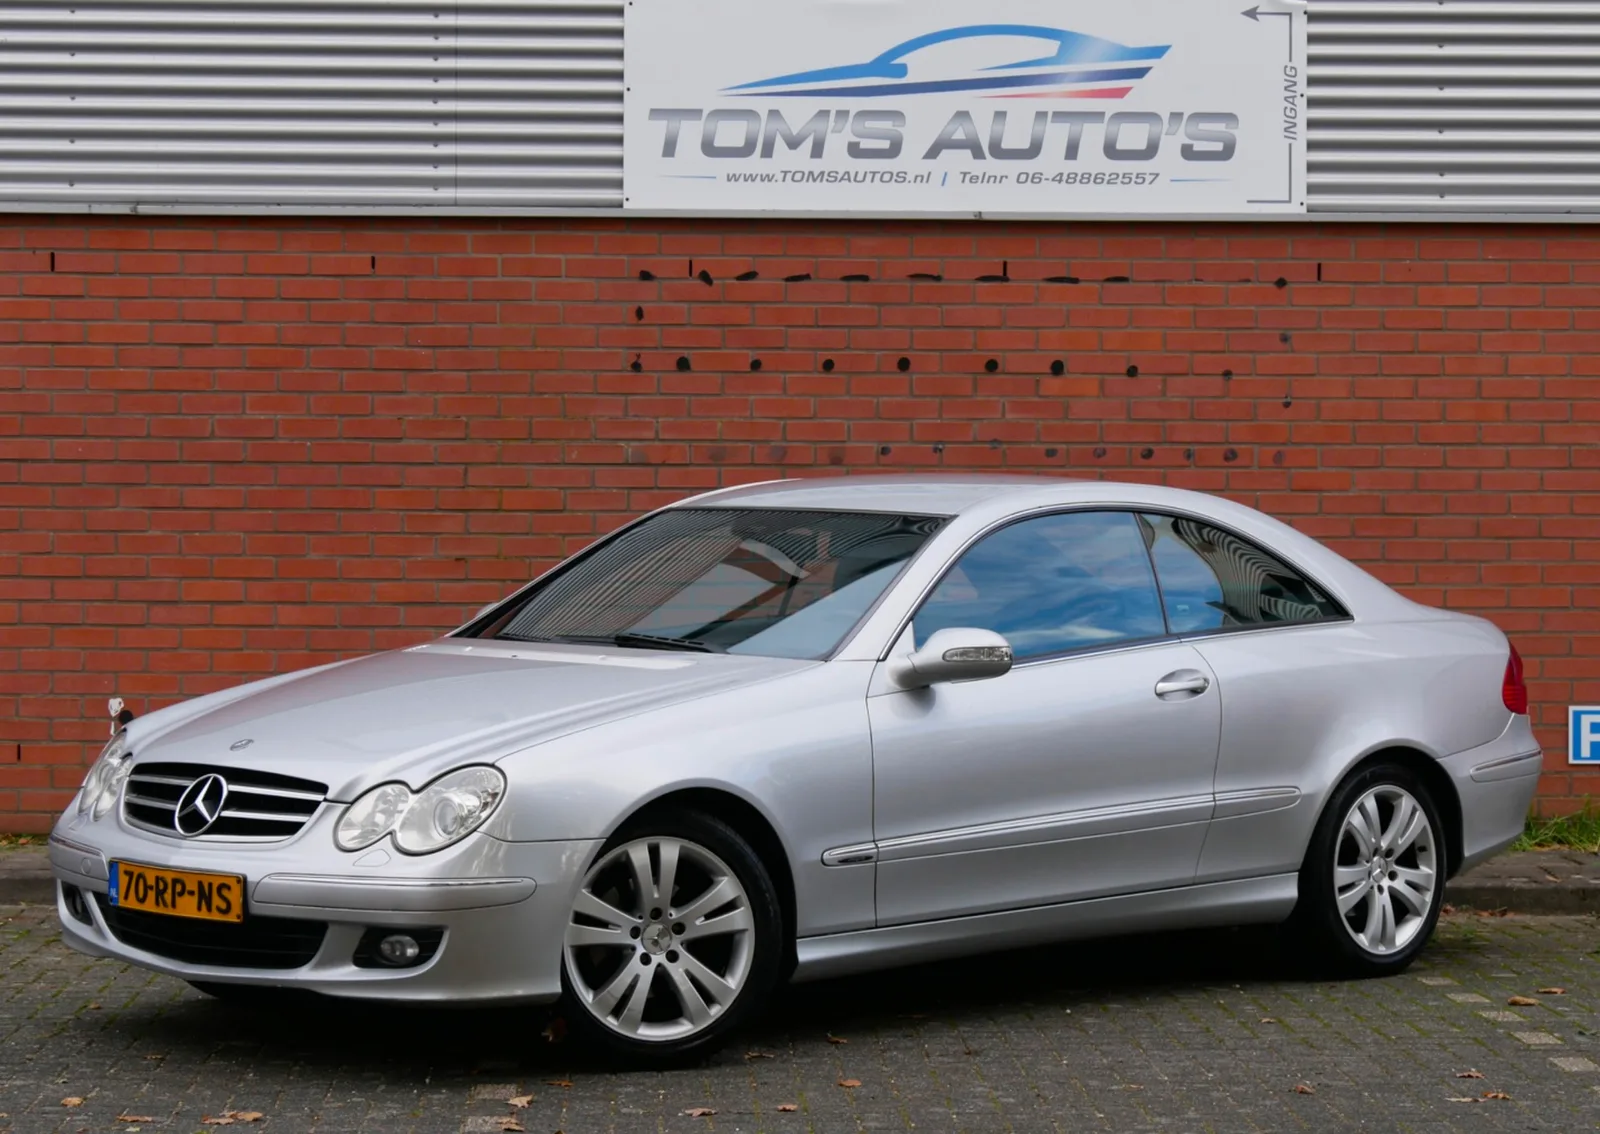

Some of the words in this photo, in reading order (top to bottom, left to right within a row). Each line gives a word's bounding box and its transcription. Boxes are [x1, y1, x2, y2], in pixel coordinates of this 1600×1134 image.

[1283, 64, 1298, 141] INGANG
[648, 108, 906, 160] TOM'S
[921, 110, 1240, 162] AUTO'S
[725, 170, 932, 185] www.TOMSAUTOS.nl
[959, 171, 1009, 185] Telnr
[1016, 171, 1161, 186] 06-48862557
[123, 869, 233, 916] 70-RP-NS
